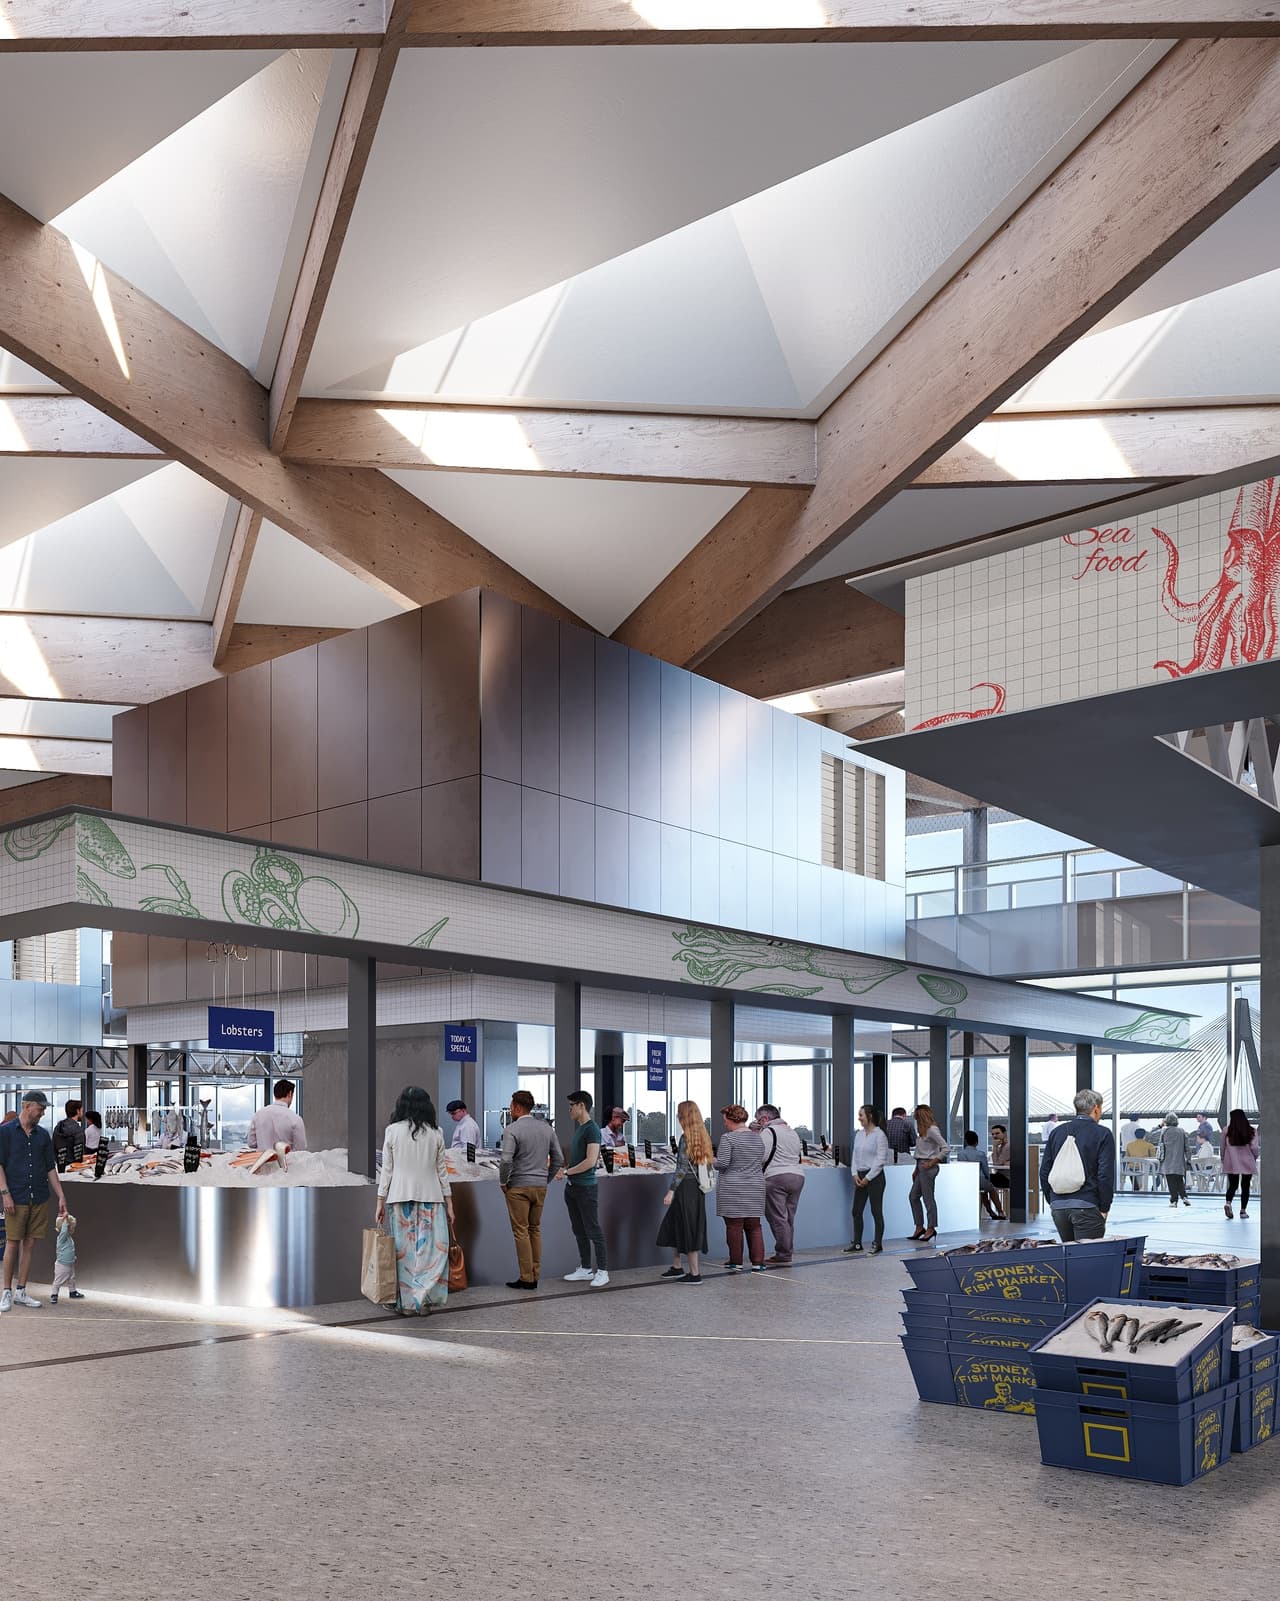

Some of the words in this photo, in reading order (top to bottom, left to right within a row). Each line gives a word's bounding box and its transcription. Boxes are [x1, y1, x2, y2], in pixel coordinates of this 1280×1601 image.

[1072, 548, 1148, 580] food
[221, 1024, 263, 1037] Lobsters
[450, 1045, 471, 1053] SPECIAL
[974, 1265, 1034, 1281] SYDNEY
[964, 1281, 994, 1296] FISH
[997, 1276, 1057, 1287] MARKET
[971, 1364, 1029, 1375] SYDNEY
[959, 1375, 987, 1384] FISH
[991, 1374, 1037, 1386] MARKE
